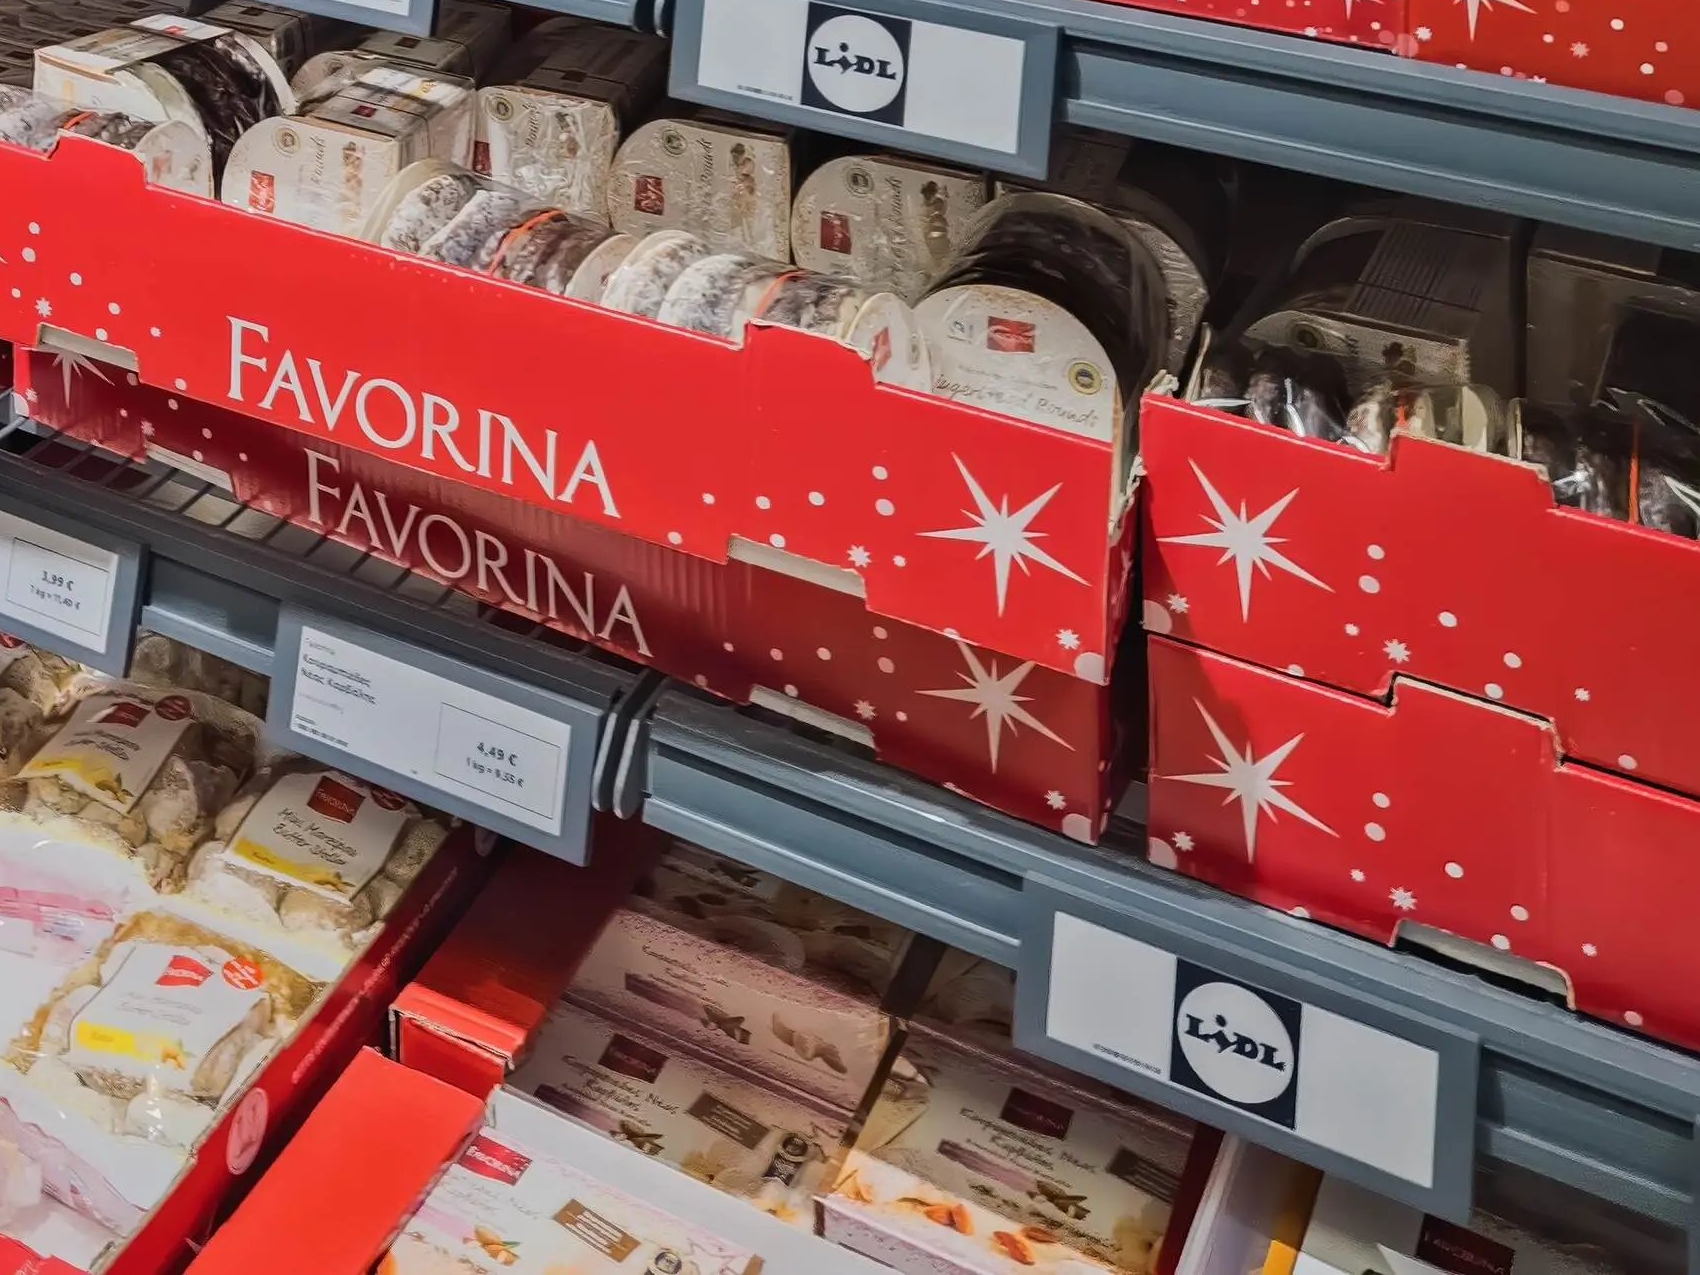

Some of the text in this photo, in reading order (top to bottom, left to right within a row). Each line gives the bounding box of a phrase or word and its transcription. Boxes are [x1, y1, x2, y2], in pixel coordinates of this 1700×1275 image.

[226, 314, 622, 520] FAVORINA
[303, 447, 654, 659] FAVORINA
[475, 740, 520, 768] 4,49 €
